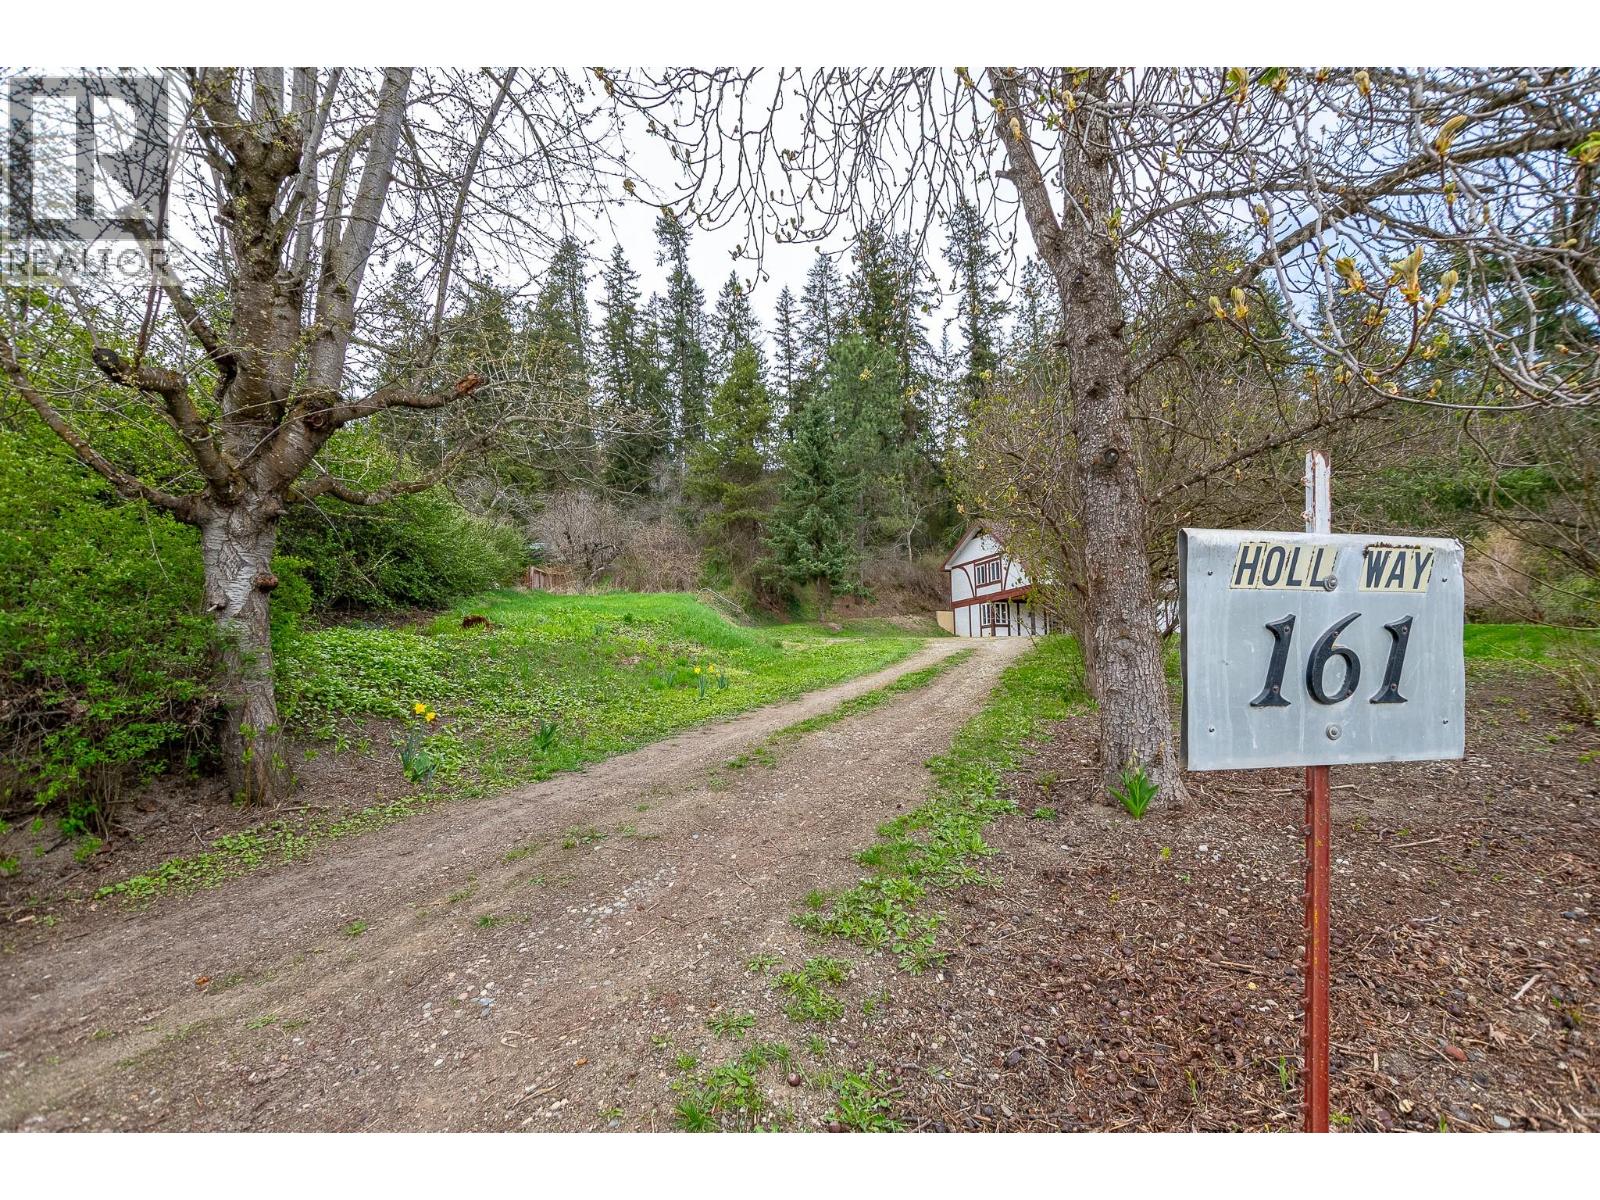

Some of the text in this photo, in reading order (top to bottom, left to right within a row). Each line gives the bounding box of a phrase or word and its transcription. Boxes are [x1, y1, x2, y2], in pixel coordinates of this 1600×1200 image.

[1234, 545, 1433, 589] HOLL WAY
[1250, 612, 1413, 707] 161
